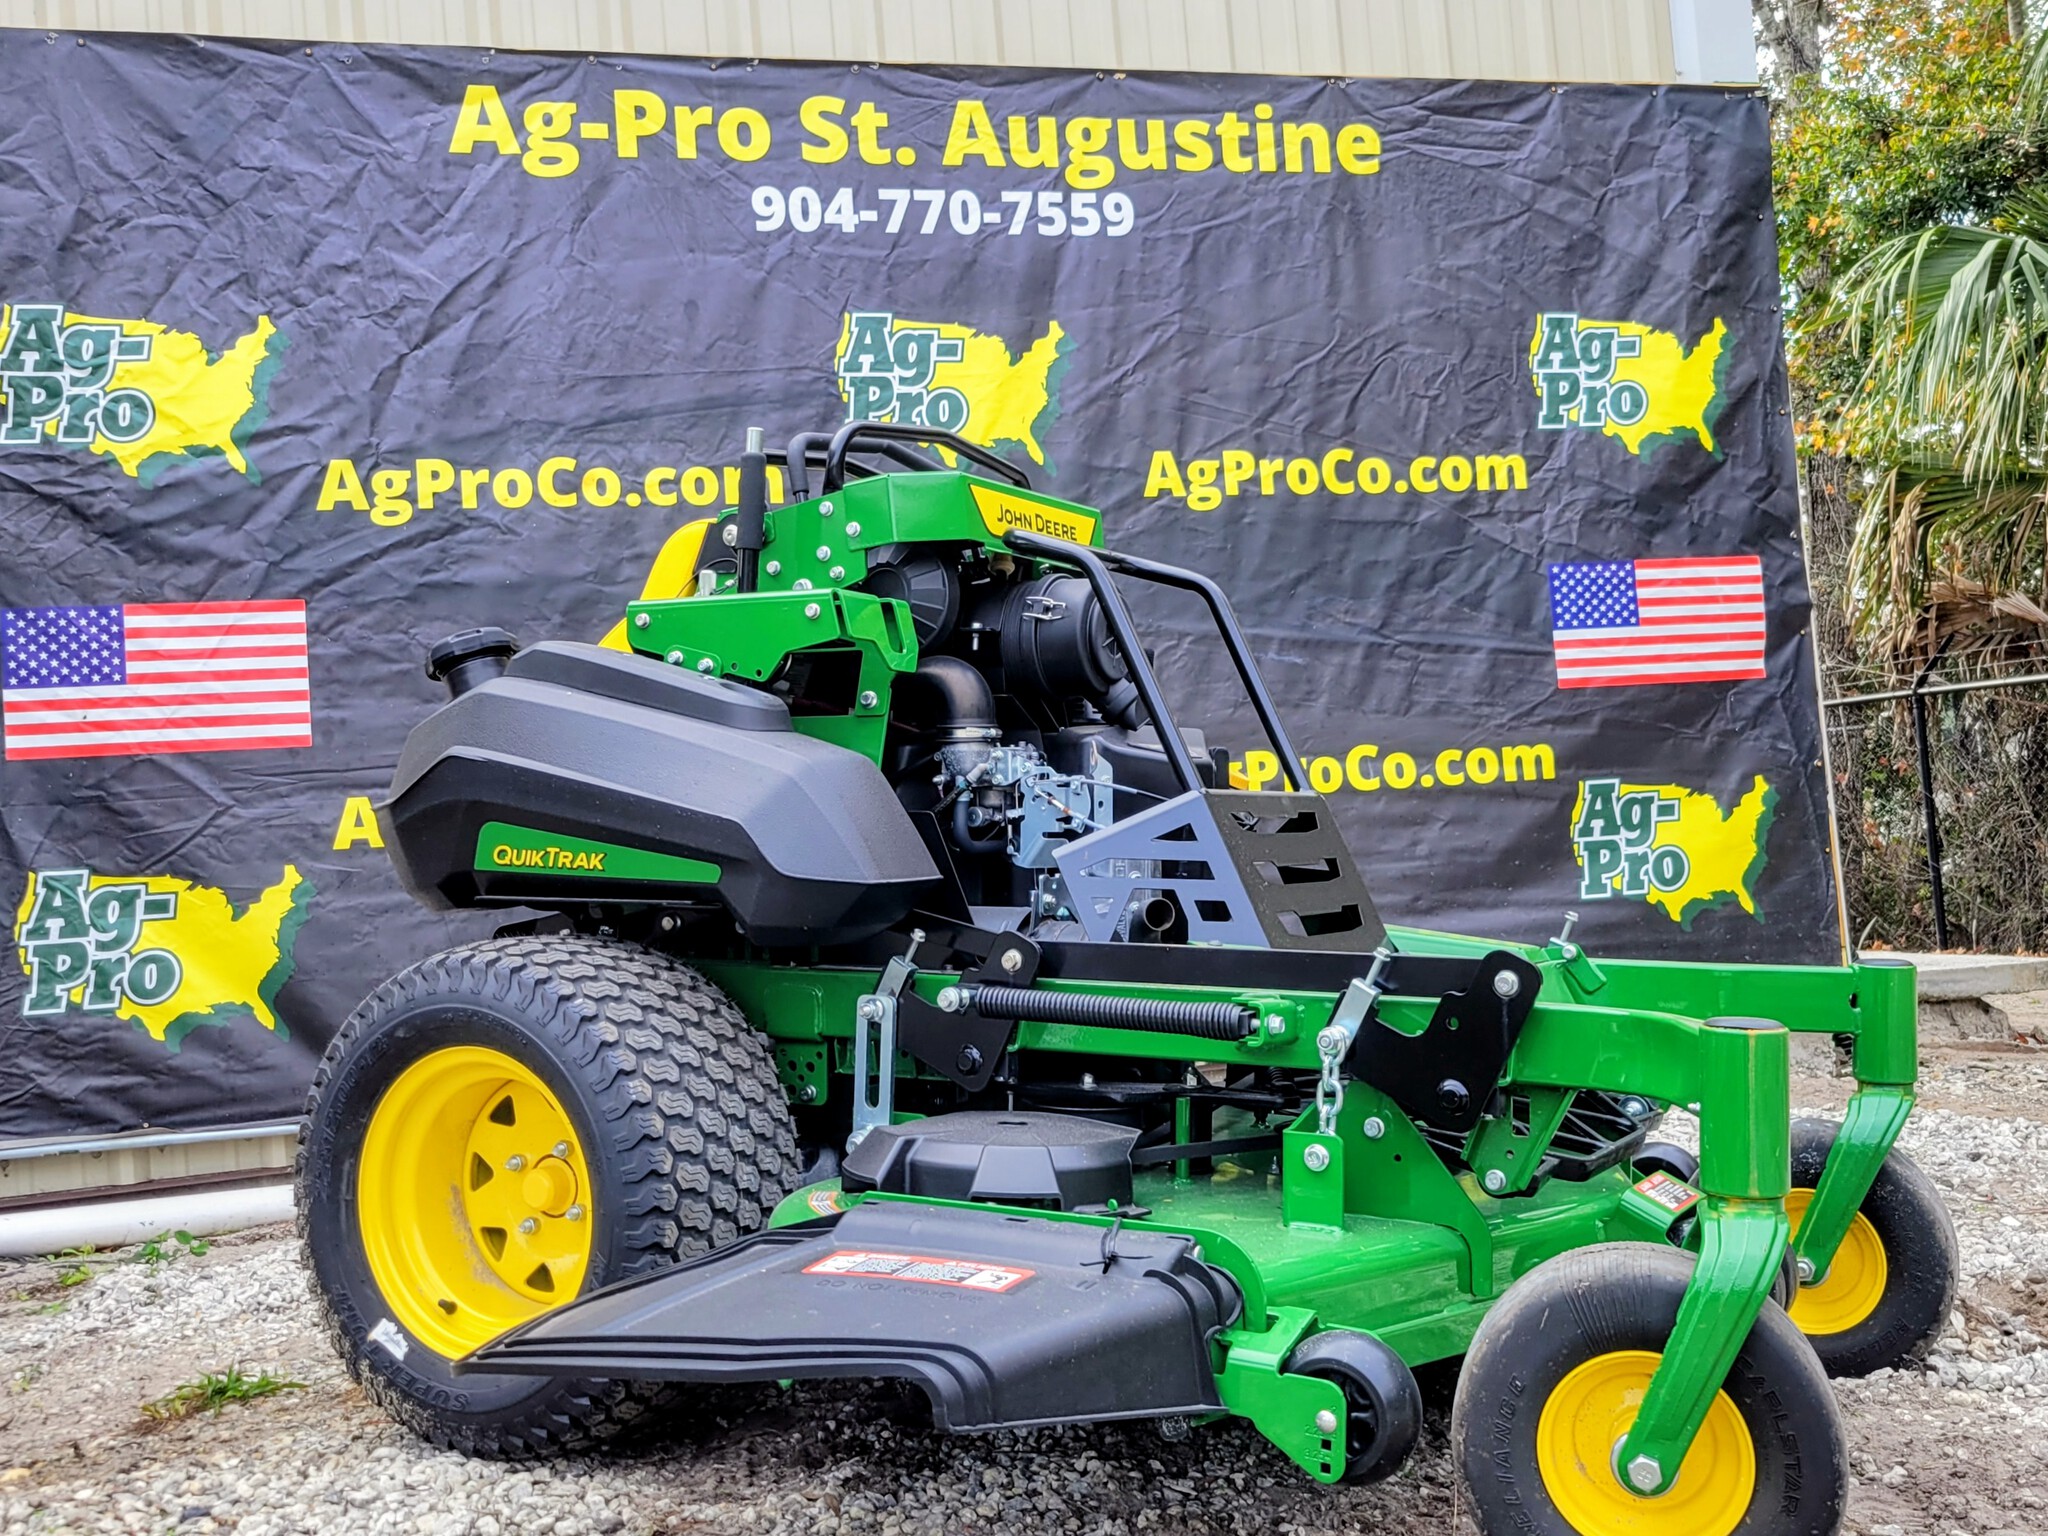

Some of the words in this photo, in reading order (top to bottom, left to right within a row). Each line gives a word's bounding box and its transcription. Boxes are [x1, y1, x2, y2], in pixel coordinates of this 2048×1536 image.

[449, 84, 772, 178] Ag-Pro
[799, 95, 917, 166] St.
[943, 102, 1382, 190] Augustine
[751, 185, 1135, 238] 904-770-7559
[0, 304, 152, 391] Ag-
[838, 312, 964, 389] Ag-
[1533, 313, 1640, 383] Ag-
[0, 374, 155, 444] Pro
[844, 375, 969, 432] Pro
[1538, 371, 1648, 429] Pro
[316, 456, 785, 527] AgProCo.com
[1143, 447, 1529, 512] AgProCo.com
[997, 504, 1033, 531] JOHN
[1035, 513, 1078, 541] DEERE
[1573, 778, 1680, 850] Ag-
[1578, 838, 1690, 899] Pro
[20, 869, 176, 955] Ag-
[23, 943, 181, 1016] Pro
